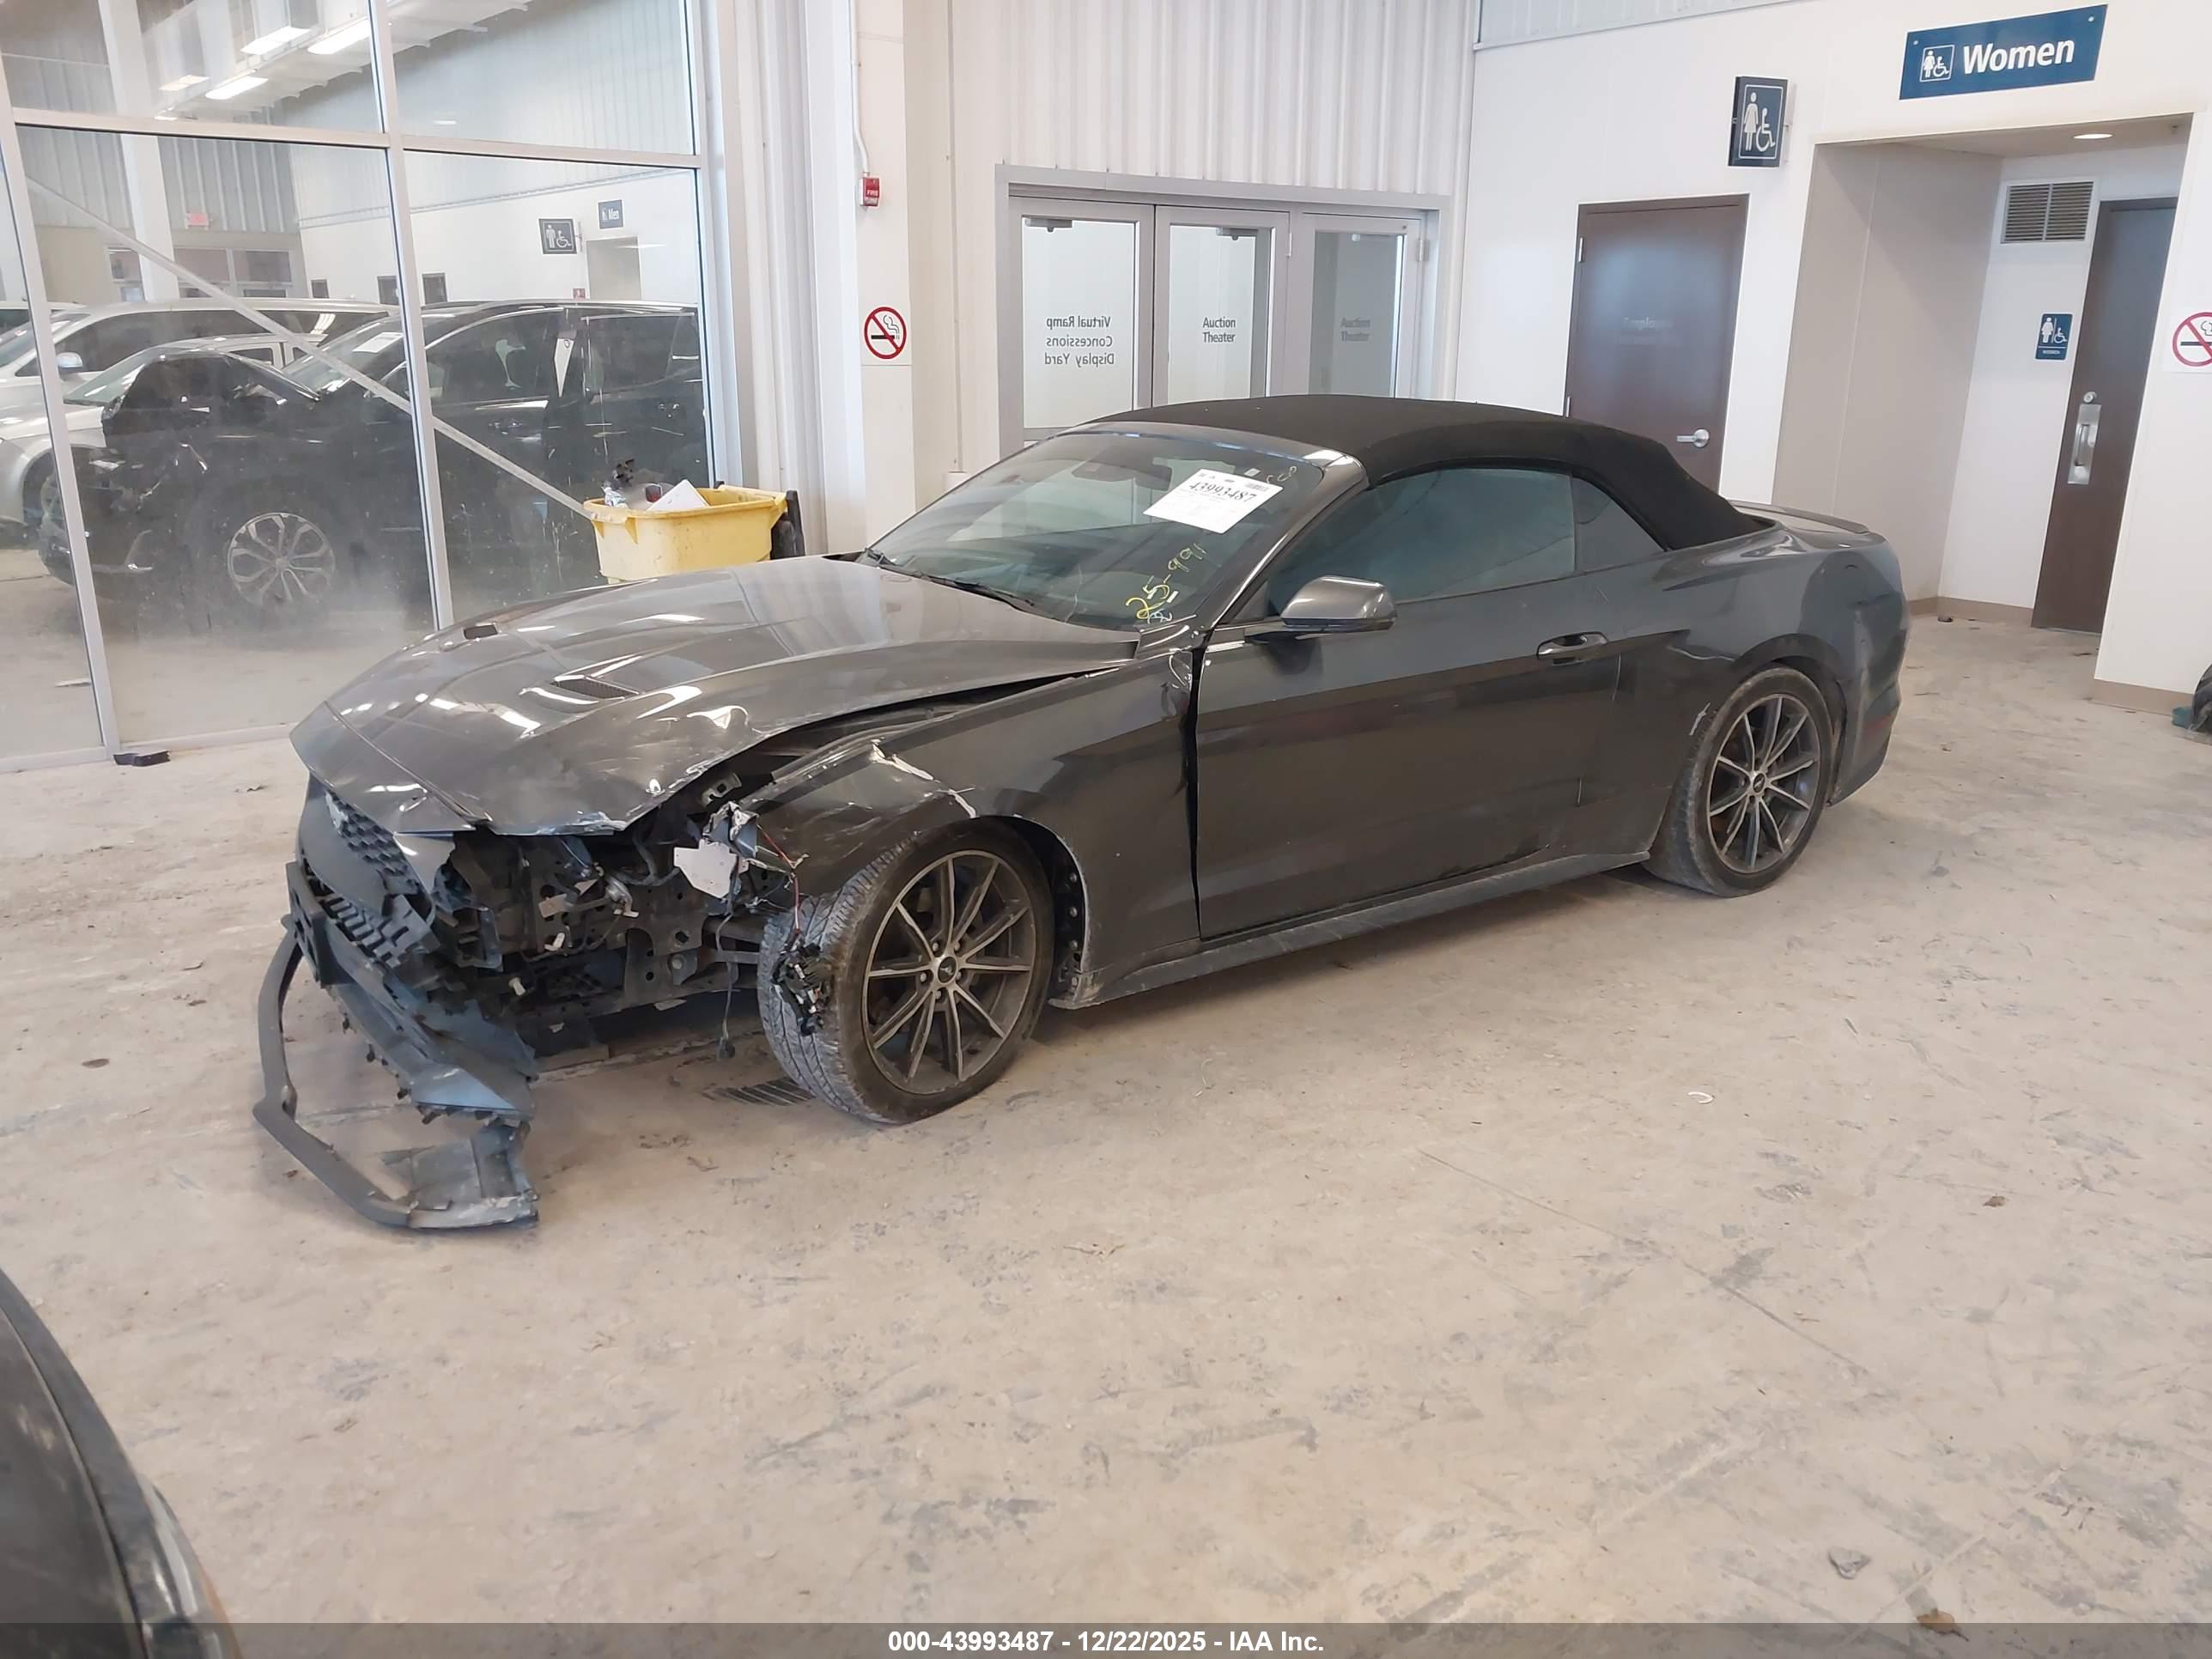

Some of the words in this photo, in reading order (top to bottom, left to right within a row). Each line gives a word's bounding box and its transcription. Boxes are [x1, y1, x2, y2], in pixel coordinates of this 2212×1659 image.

[1964, 40, 2075, 75] Women
[1202, 316, 1237, 328] Auction
[1202, 331, 1236, 343] Theater
[1189, 482, 1258, 502] 43993487
